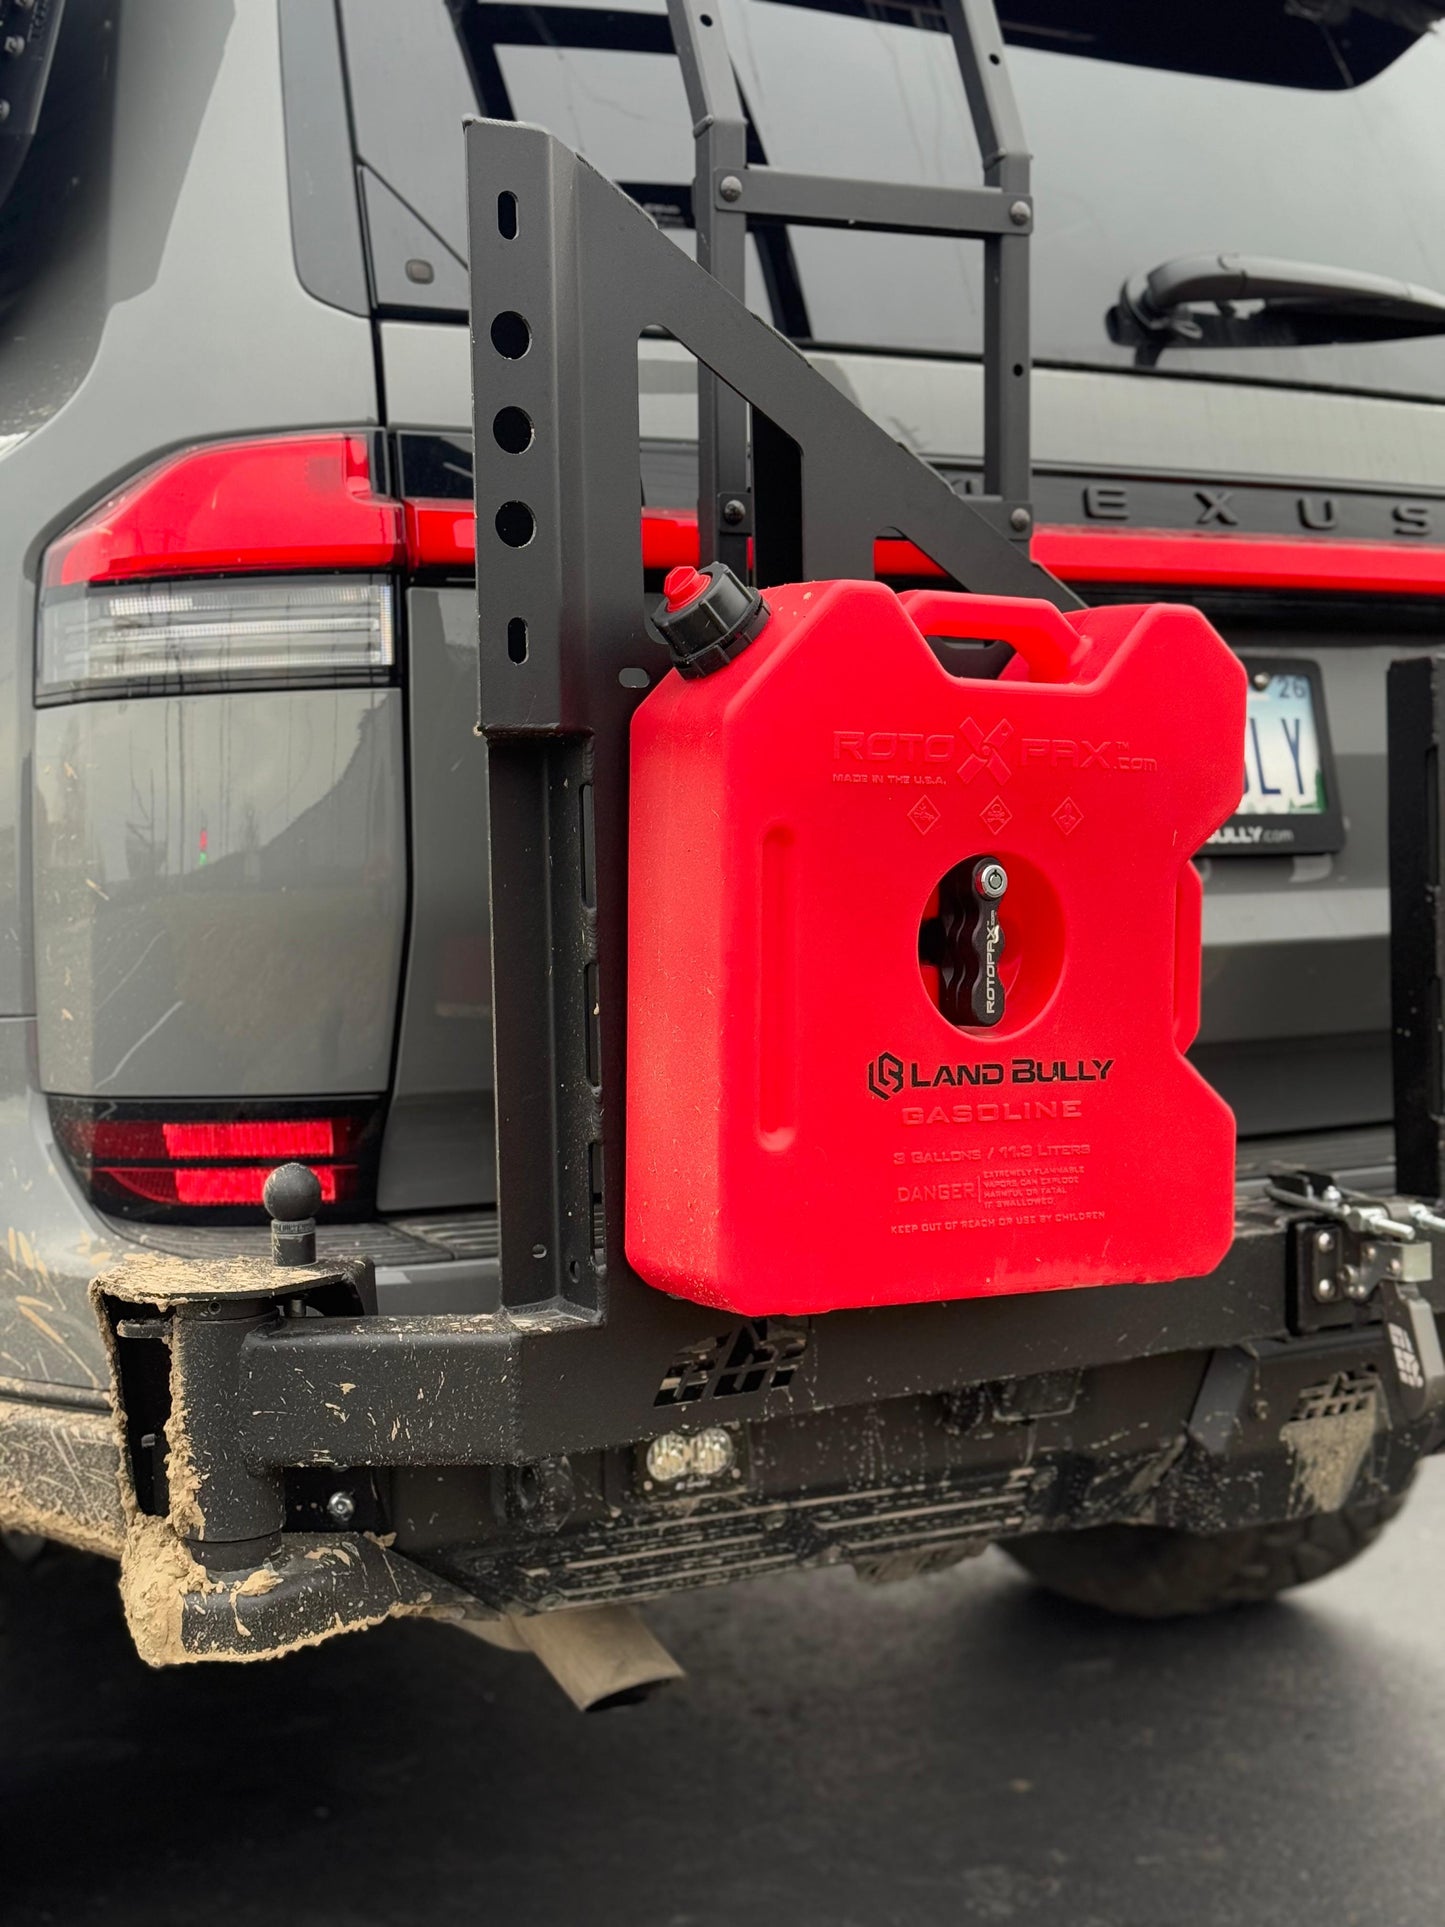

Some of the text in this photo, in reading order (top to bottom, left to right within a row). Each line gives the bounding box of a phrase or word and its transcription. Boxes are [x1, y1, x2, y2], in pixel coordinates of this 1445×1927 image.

[1278, 677, 1307, 699] 26
[1244, 717, 1305, 795] LY
[832, 773, 947, 786] MADE IN THE U.S.A.
[911, 1063, 1004, 1088] LAND
[1011, 1058, 1115, 1084] BULLY
[902, 1100, 1082, 1126] GASOLINE
[893, 1152, 906, 1165] 3
[911, 1149, 981, 1164] GALLONS
[998, 1145, 1033, 1159] 11.3
[1038, 1144, 1091, 1157] LITERS
[983, 1166, 1085, 1179] EXTREMELY FLAMMABLE
[1020, 1177, 1038, 1187] CAN
[1040, 1176, 1080, 1186] EXPLODE
[897, 1182, 977, 1203] DANGER
[1026, 1188, 1039, 1197] OR
[1041, 1186, 1068, 1196] FATAL
[890, 1210, 1105, 1234] KEEP OUT OF REACH OR USE BY CHILDREN
